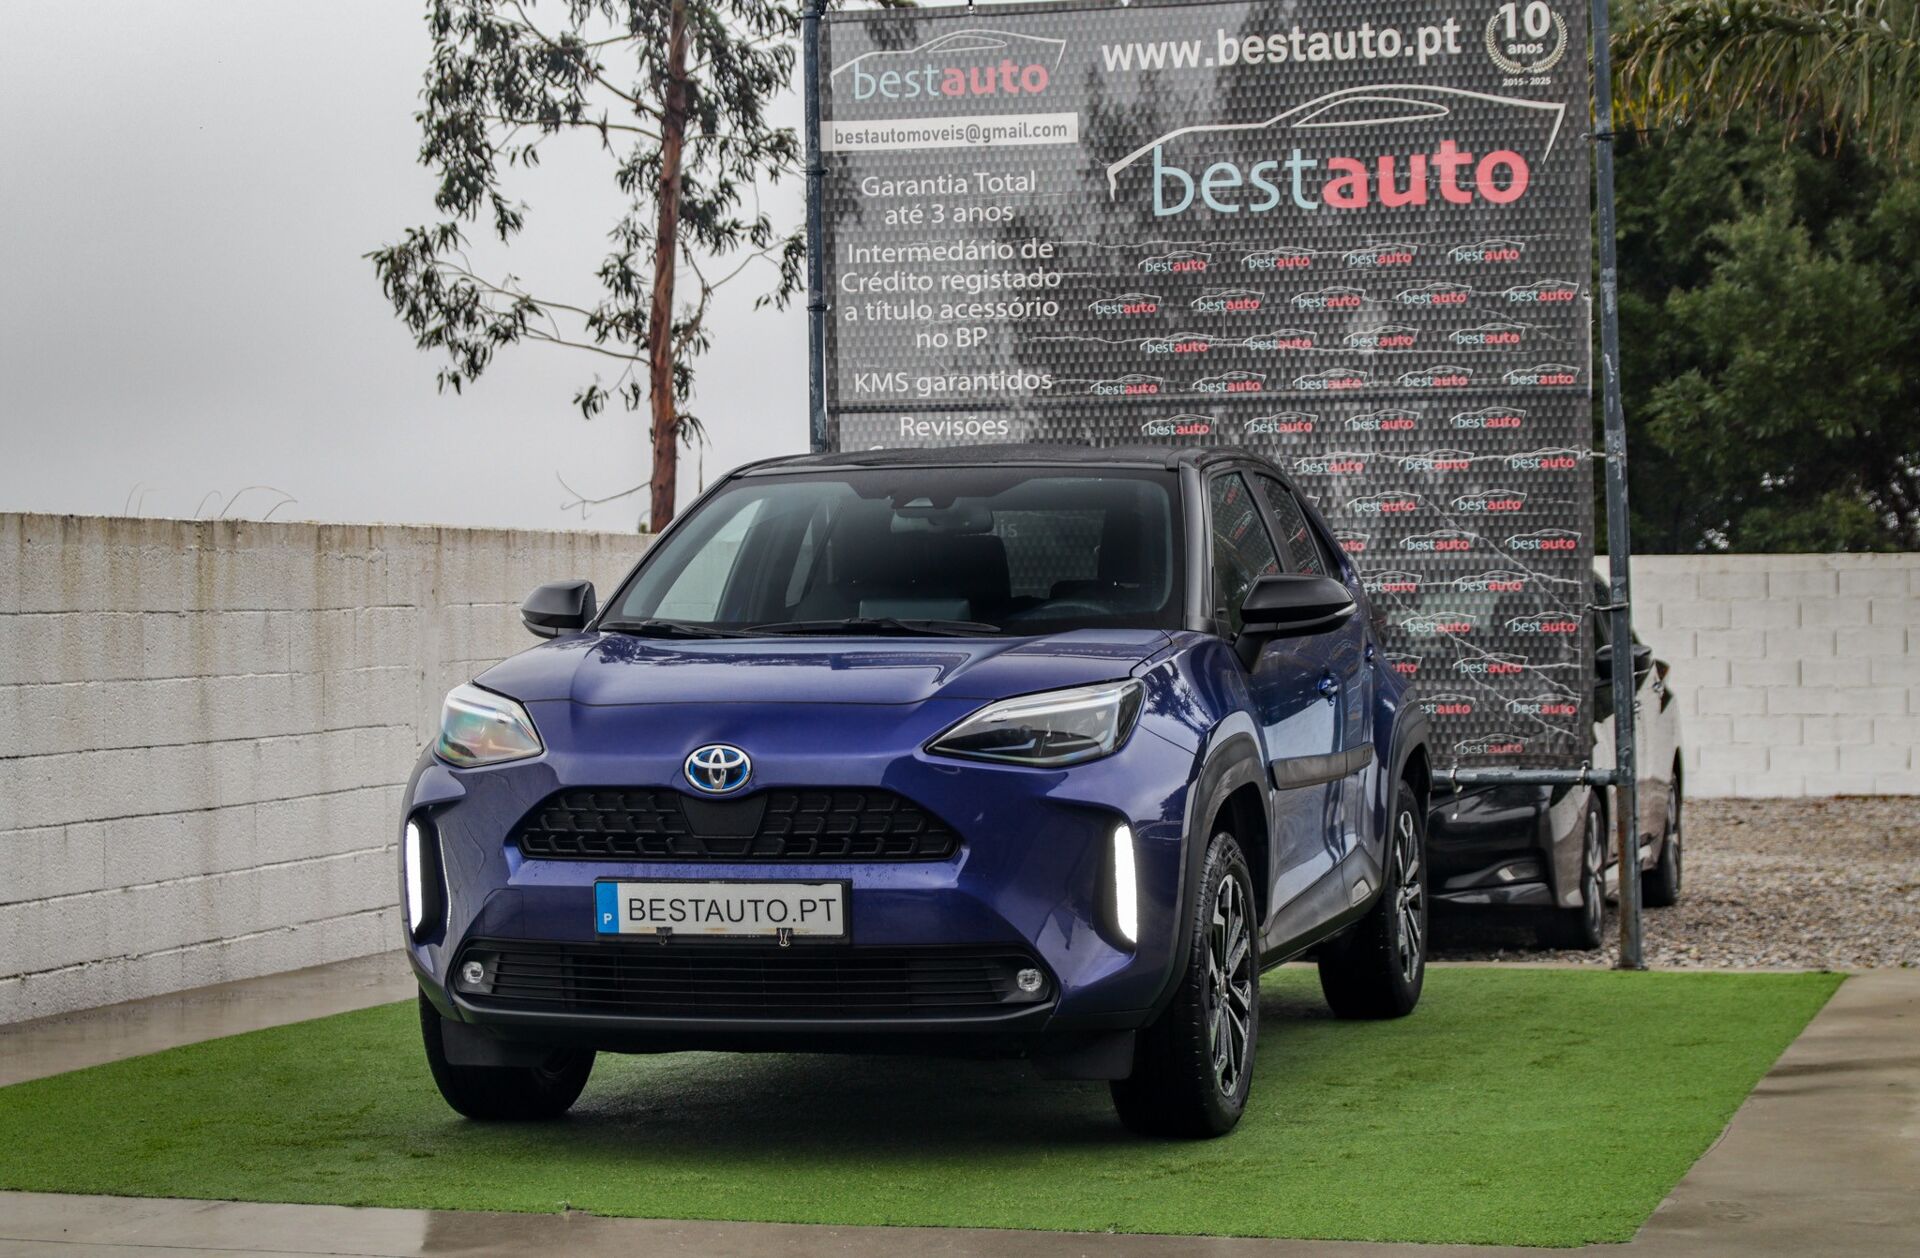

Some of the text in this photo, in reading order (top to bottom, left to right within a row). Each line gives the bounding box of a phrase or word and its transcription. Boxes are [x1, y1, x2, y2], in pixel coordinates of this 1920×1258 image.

[1499, 1, 1550, 38] 10
[1102, 18, 1462, 71] www.bestauto.pt
[1507, 43, 1543, 54] anos
[854, 58, 1049, 100] bestauto
[835, 122, 1067, 144] bestautomoveis@gmail.com
[861, 170, 1036, 197] Garantia Total
[1153, 139, 1529, 216] bestauto
[885, 204, 1014, 225] até 3 anos
[848, 238, 1053, 264] Intermedário de
[1456, 249, 1519, 261] bestauto
[1249, 256, 1311, 269] bestauto
[1350, 252, 1412, 265] bestauto
[1146, 260, 1206, 273] bestauto
[841, 267, 1061, 294] Crédito registado
[1404, 292, 1466, 304] bestauto
[1510, 289, 1573, 301] bestauto
[1199, 300, 1259, 312] bestauto
[1299, 296, 1360, 308] bestauto
[845, 297, 1059, 322] a título acessório
[1096, 303, 1156, 315] bestauto
[916, 327, 988, 348] no BP
[1250, 338, 1311, 350] bestauto
[1352, 335, 1414, 348] bestauto
[1457, 332, 1520, 345] bestauto
[1148, 341, 1208, 353] bestauto
[855, 369, 1052, 397] KMS garantidos
[1300, 377, 1362, 390] bestauto
[1404, 374, 1468, 387] bestauto
[1511, 372, 1574, 385] bestauto
[1097, 383, 1158, 395] bestauto
[1200, 379, 1261, 392] bestauto
[900, 416, 1008, 436] Revisões
[1252, 420, 1312, 434] bestauto
[1353, 418, 1414, 430] bestauto
[1458, 416, 1520, 428] bestauto
[1149, 423, 1209, 436] bestauto
[1302, 460, 1363, 473] bestauto
[1406, 458, 1468, 471] bestauto
[1512, 456, 1575, 469] bestauto
[1355, 499, 1415, 512] bestauto
[1459, 498, 1521, 510] bestauto
[1408, 538, 1469, 551] bestauto
[1512, 537, 1576, 550] bestauto
[1362, 580, 1416, 593] estauto
[1460, 579, 1522, 592] bestauto
[1408, 620, 1470, 632] bestauto
[1513, 620, 1576, 632] bestauto
[1461, 660, 1522, 673] bestauto
[1514, 702, 1576, 714] bestauto
[1461, 743, 1523, 754] bestauto
[603, 898, 836, 925] P BESTAUTO.PT
